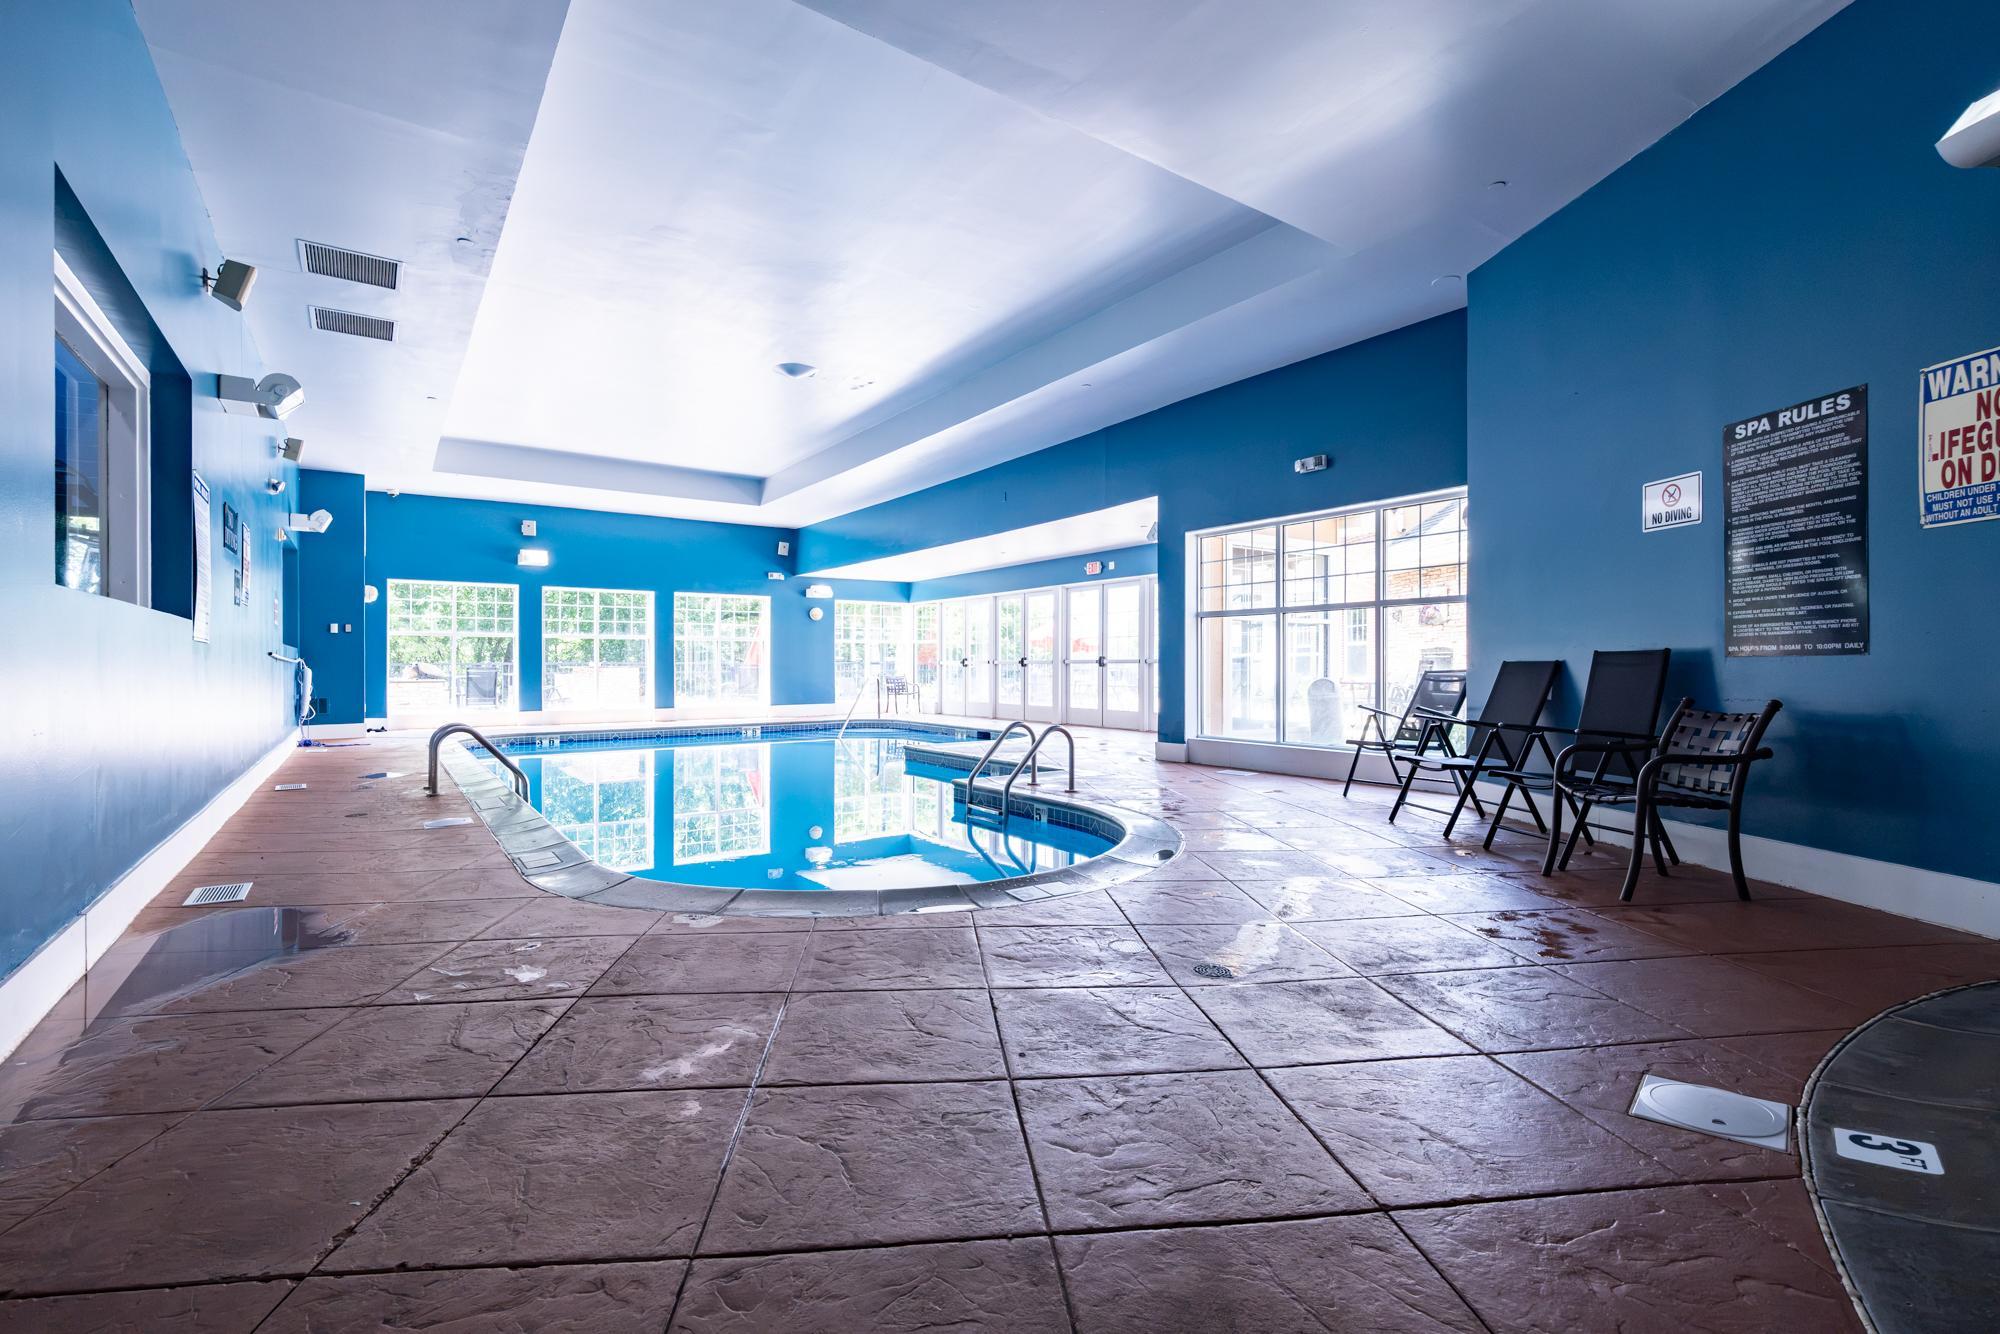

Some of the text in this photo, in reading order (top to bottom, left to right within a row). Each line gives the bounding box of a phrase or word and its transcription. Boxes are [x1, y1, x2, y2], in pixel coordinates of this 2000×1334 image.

[1734, 394, 1851, 440] SPA RULES
[1941, 451, 2000, 489] ON D
[1926, 484, 1996, 502] CHILDREN UNDER
[1932, 495, 1993, 512] MUST NOT USE
[1652, 507, 1692, 525] NO DIVING
[1925, 504, 1998, 522] WITHOUT AN ADULT
[1848, 1134, 1928, 1170] 3 FT
